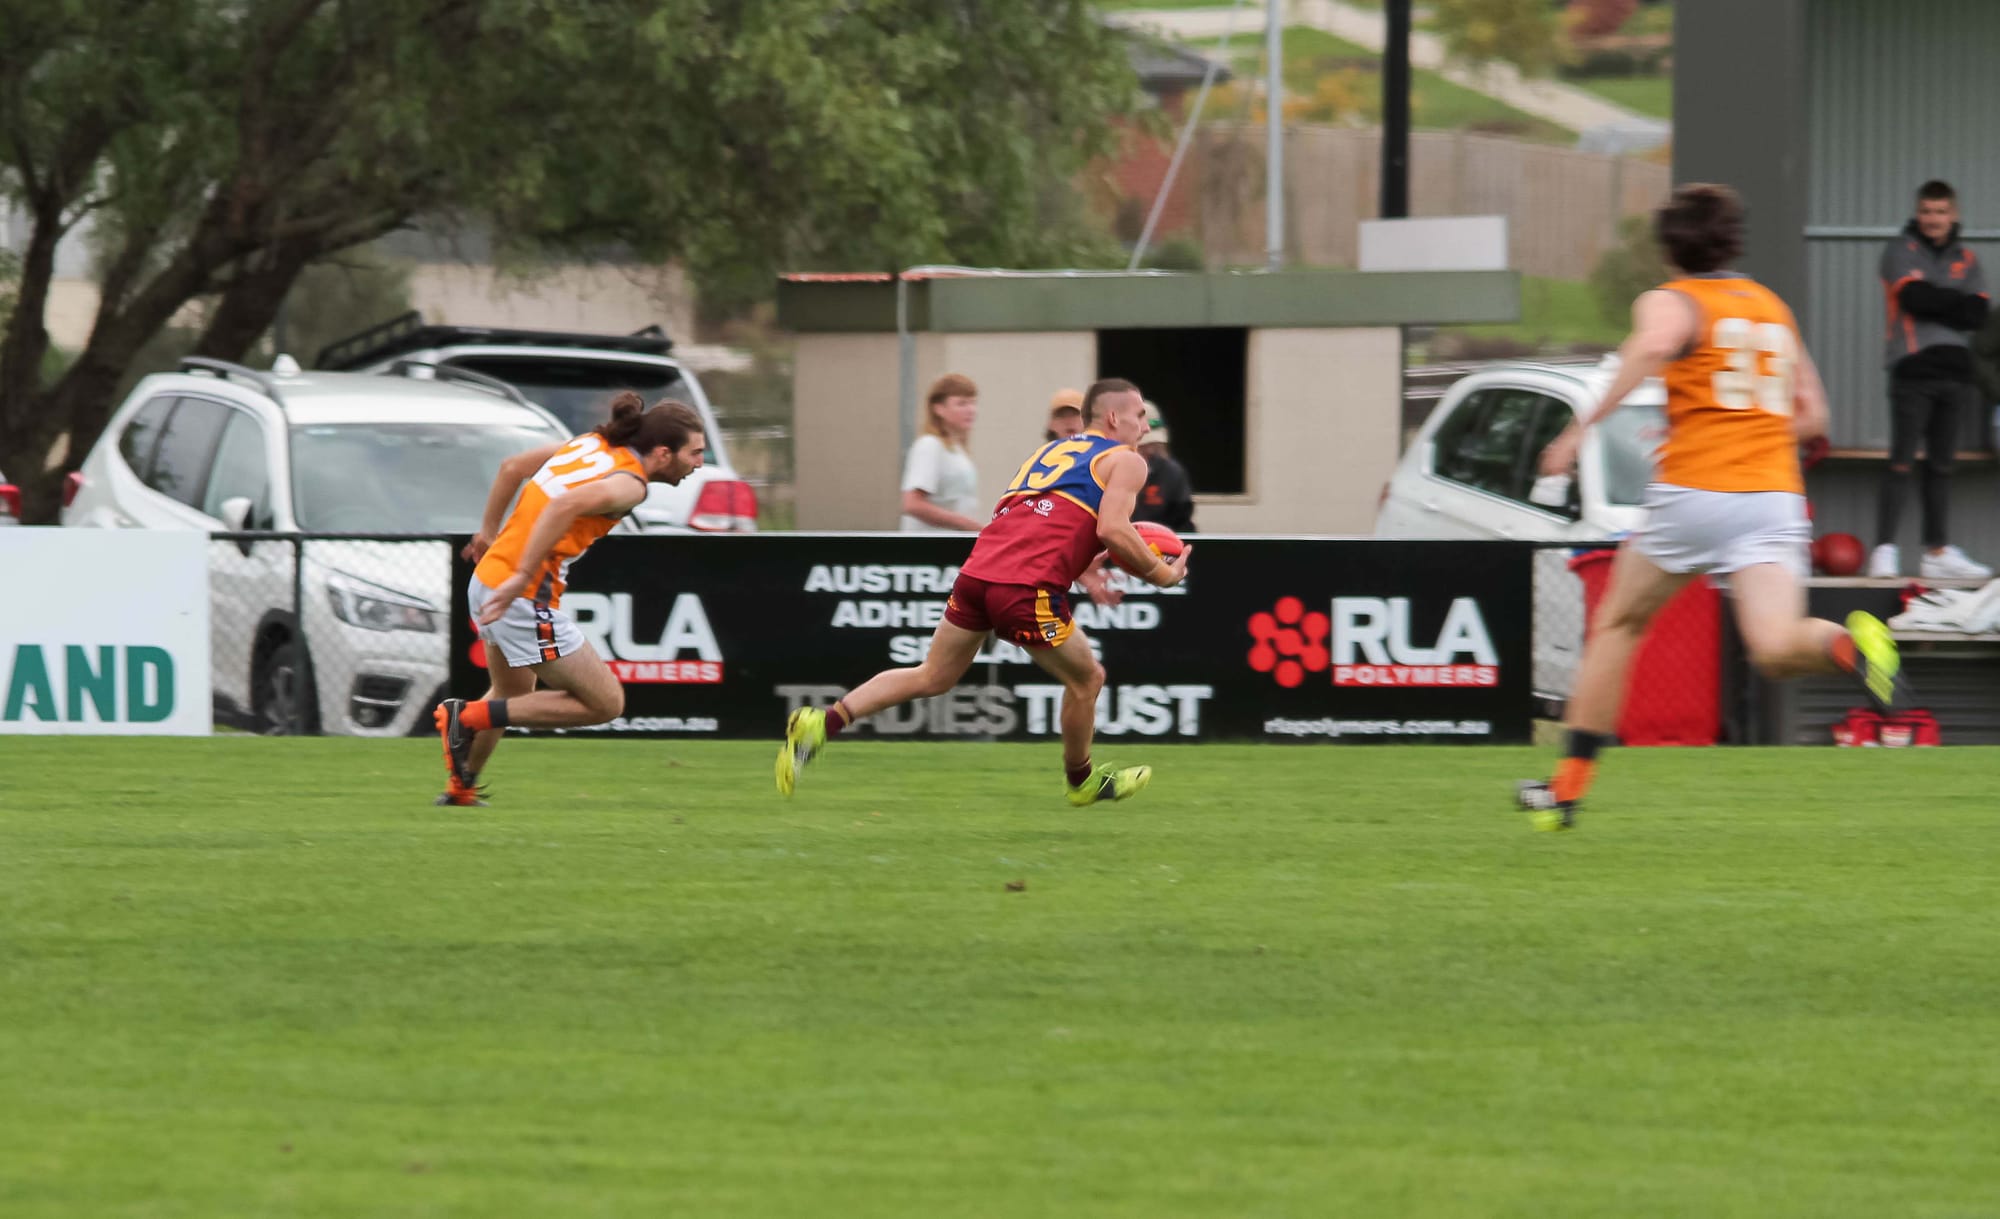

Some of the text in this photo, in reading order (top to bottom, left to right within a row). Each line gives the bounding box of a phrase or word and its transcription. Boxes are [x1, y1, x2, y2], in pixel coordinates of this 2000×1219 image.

[1711, 317, 1797, 417] 33
[529, 435, 615, 499] 22
[1007, 439, 1094, 490] 15
[558, 592, 723, 663] RLA
[1072, 602, 1161, 630] AND
[1331, 596, 1498, 665] RLA
[4, 644, 176, 723] AND
[1334, 666, 1496, 685] POLYMERS
